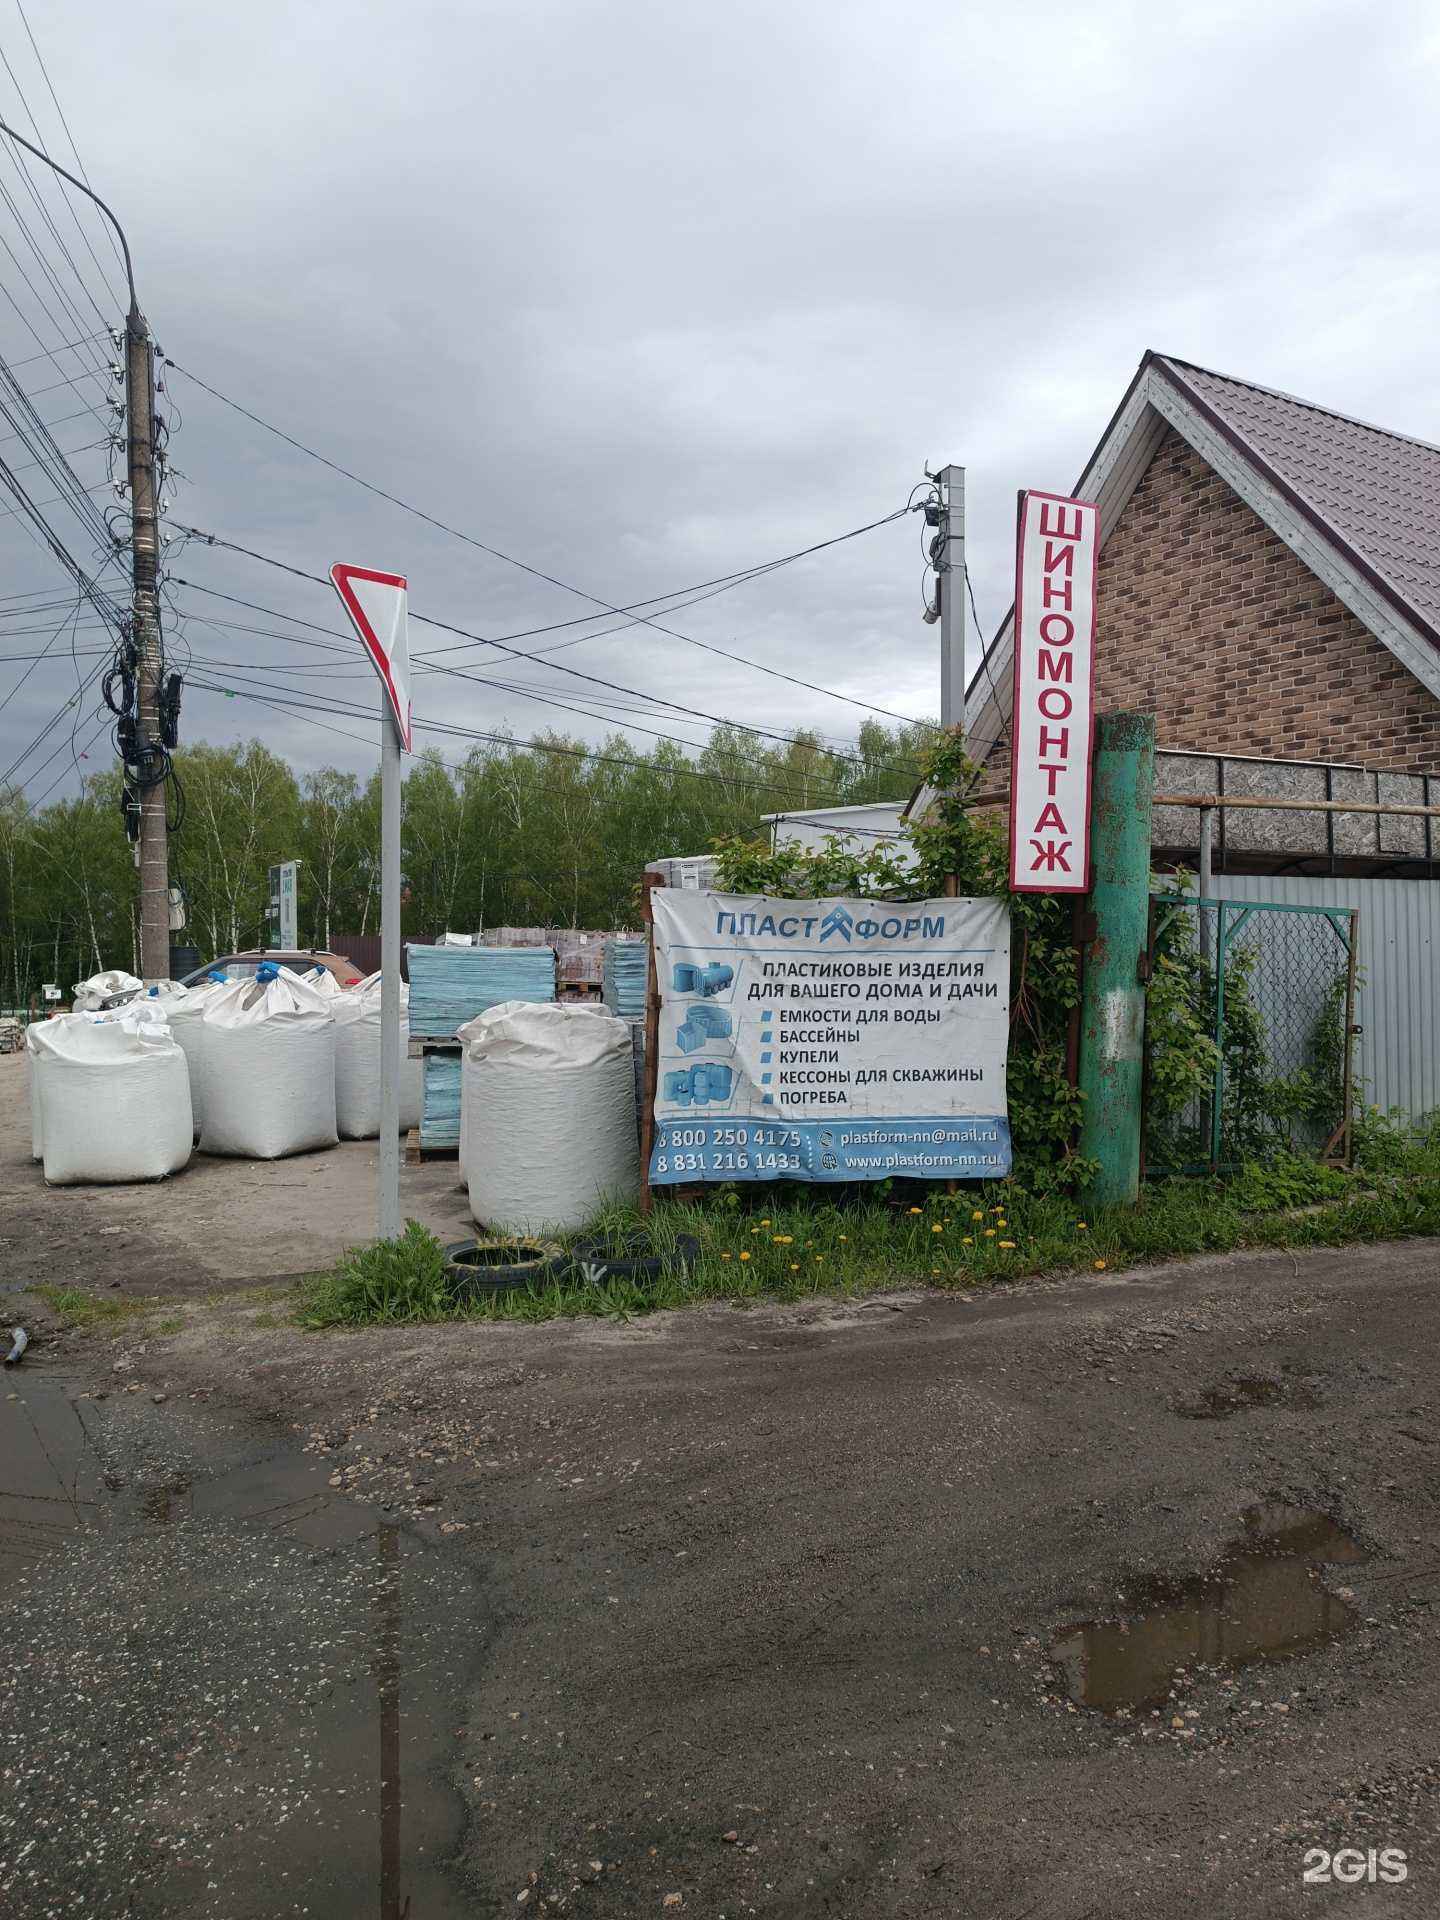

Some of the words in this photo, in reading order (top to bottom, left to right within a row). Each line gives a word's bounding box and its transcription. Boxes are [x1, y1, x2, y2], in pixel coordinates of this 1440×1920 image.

[1029, 503, 1082, 872] ШИНОМОНТАЖ
[763, 962, 893, 978] ПЛАСТИКОВЫЕ
[899, 962, 984, 978] ИЗДЕЛИЯ
[747, 983, 784, 1000] ДЛЯ
[790, 983, 860, 998] ВАШЕГО
[866, 983, 923, 1000] ДОМА
[930, 984, 942, 998] И
[948, 983, 998, 1000] ДАЧИ
[780, 1009, 850, 1023] ЕМКОСТИ
[856, 1009, 888, 1026] ДЛЯ
[894, 1009, 941, 1025] ВОДЫ
[780, 1027, 860, 1043] БАССЕЙНЫ
[780, 1051, 839, 1064] КУПЕЛИ
[780, 1070, 850, 1084] КЕССОНЫ
[856, 1070, 887, 1086] ДЛЯ
[893, 1068, 983, 1083] СКВАЖИНЫ
[780, 1091, 847, 1105] ПОГРЕБА
[672, 1130, 706, 1147] 800
[712, 1129, 747, 1146] 250
[753, 1129, 801, 1147] 4175
[841, 1129, 997, 1146] plastform-nn@mail.ru
[657, 1158, 668, 1173] 8
[674, 1154, 706, 1172] 831
[712, 1154, 748, 1170] 216
[755, 1154, 801, 1170] 1433
[845, 1152, 997, 1169] www.plastform-nn.ru
